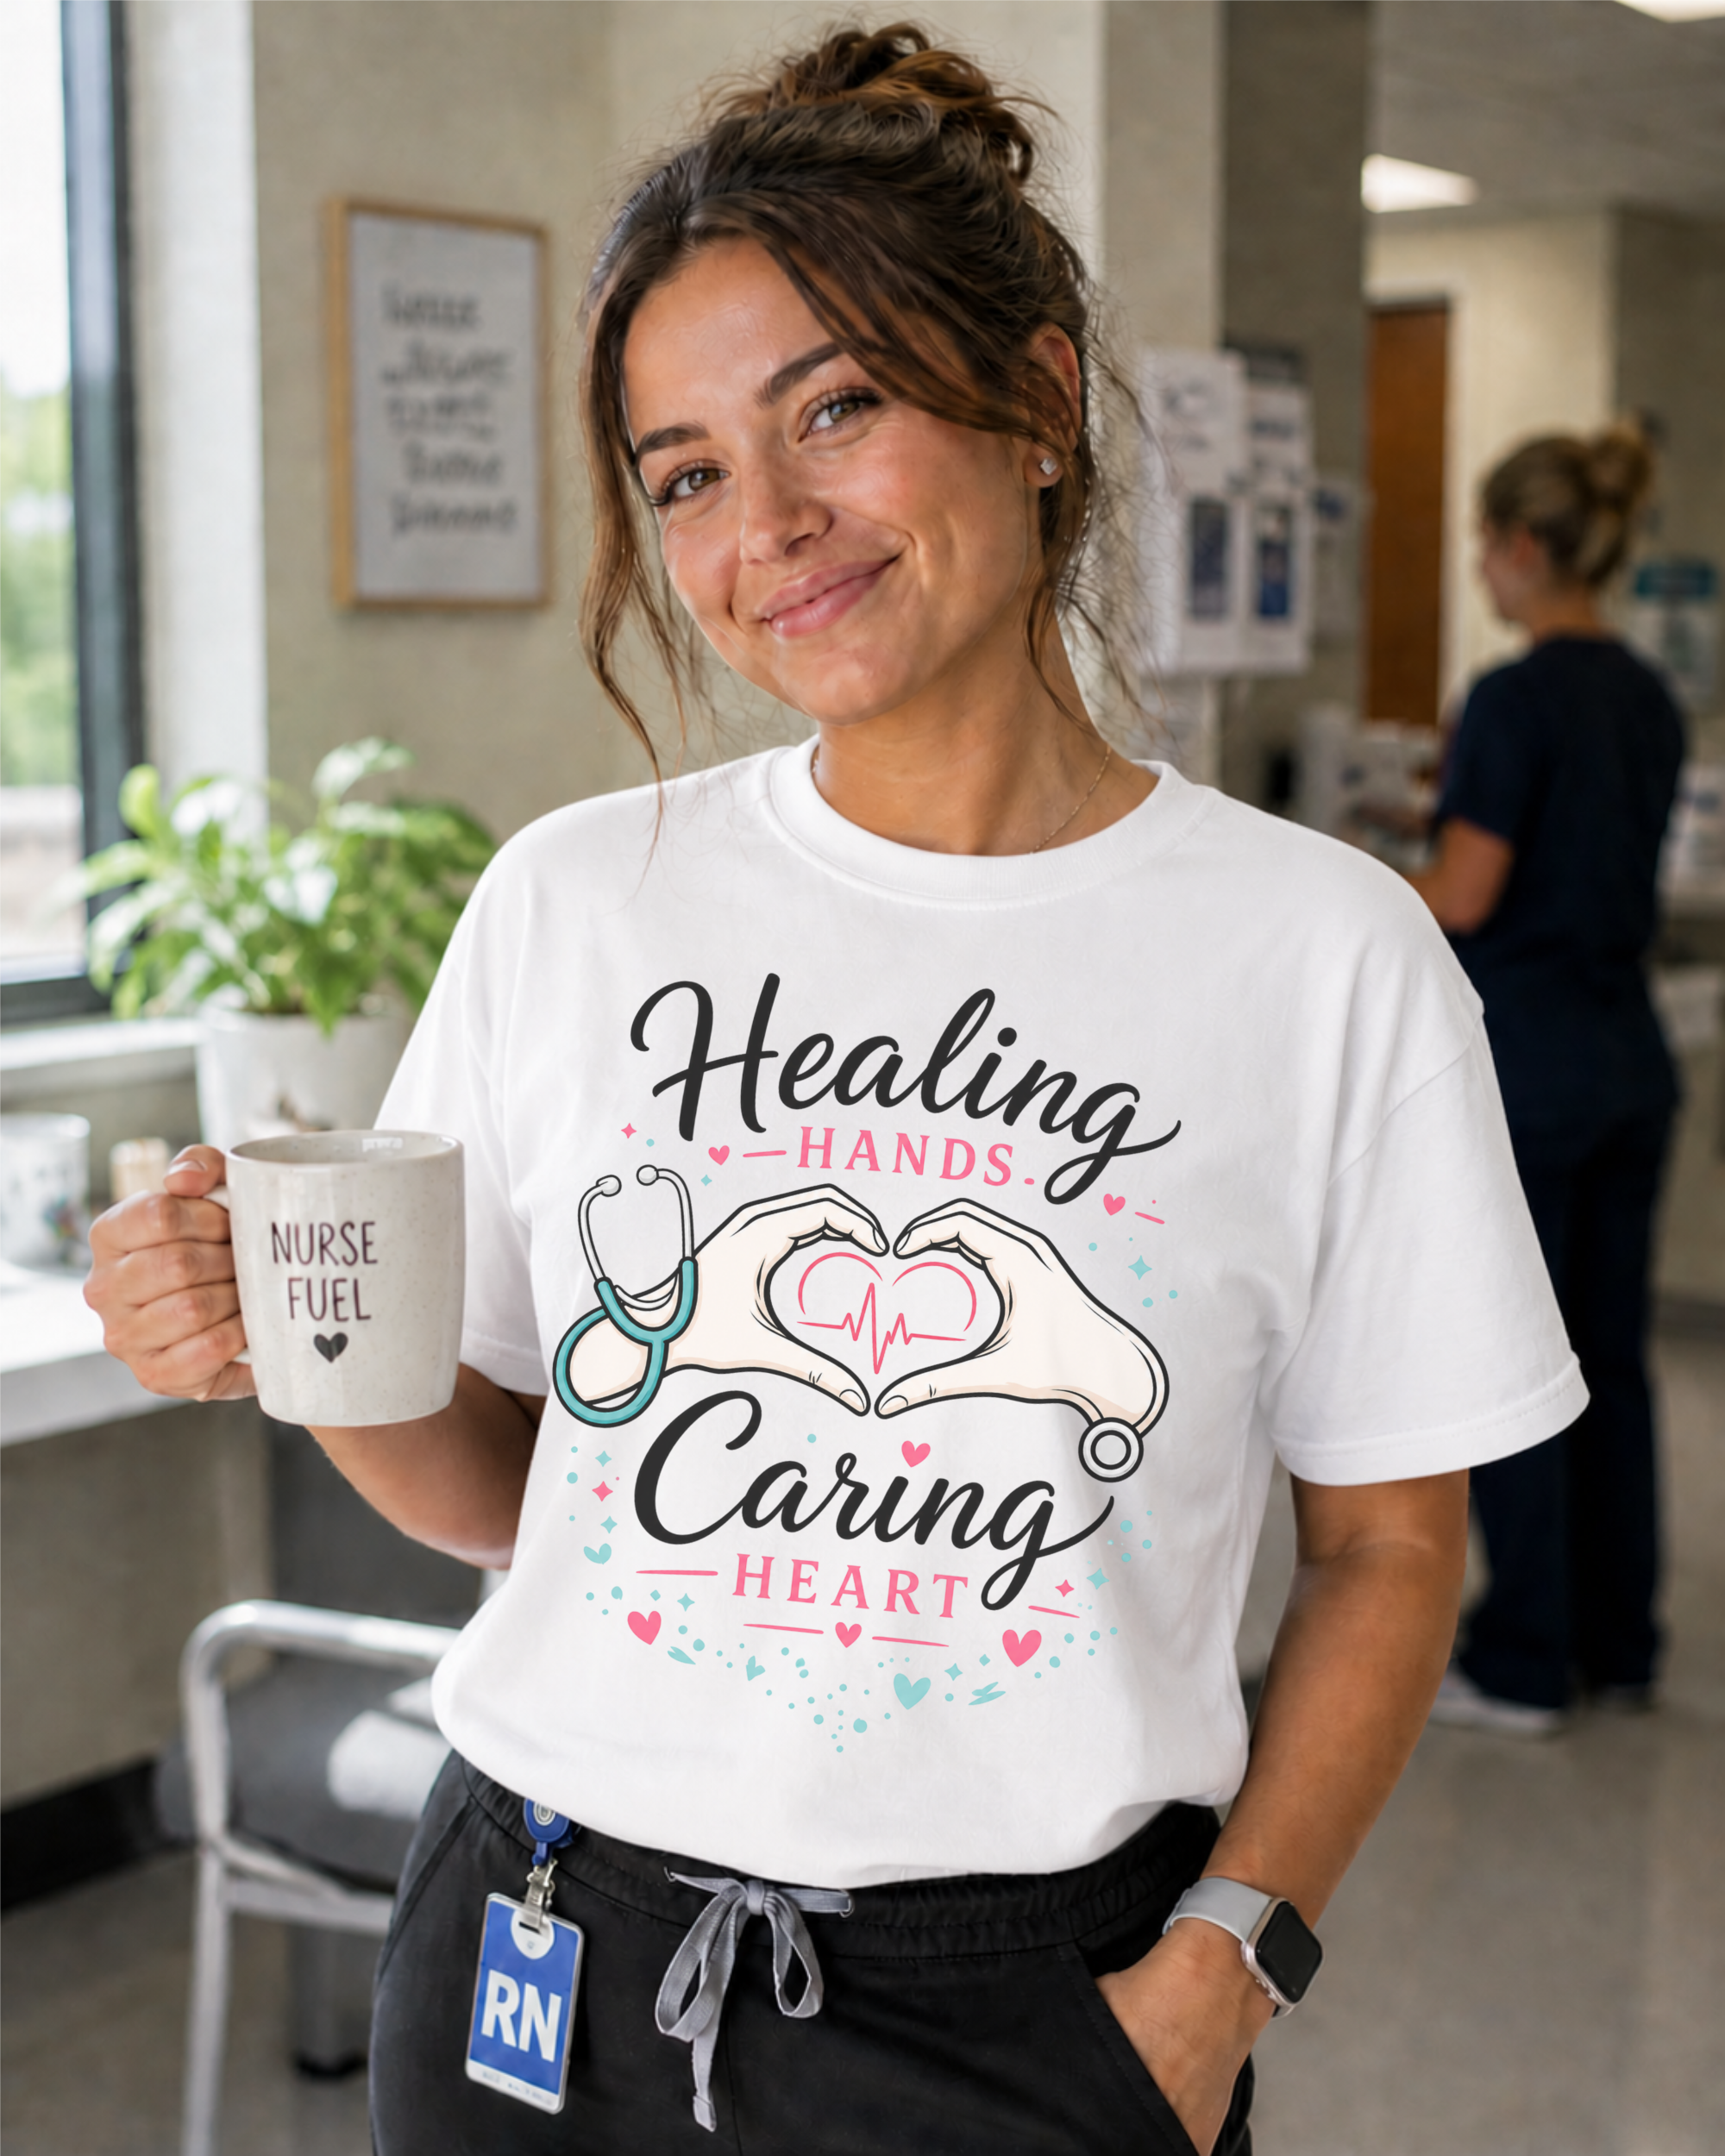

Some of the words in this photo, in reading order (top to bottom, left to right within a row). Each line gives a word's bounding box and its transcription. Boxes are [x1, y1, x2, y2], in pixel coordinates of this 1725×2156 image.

[630, 973, 1182, 1206] Healing
[797, 1126, 1014, 1187] HANDS
[271, 1221, 379, 1267] NURSE
[287, 1277, 372, 1322] FUEL
[634, 1390, 1114, 1611] Caring
[732, 1552, 969, 1619] HEART
[480, 1969, 562, 2064] RN
